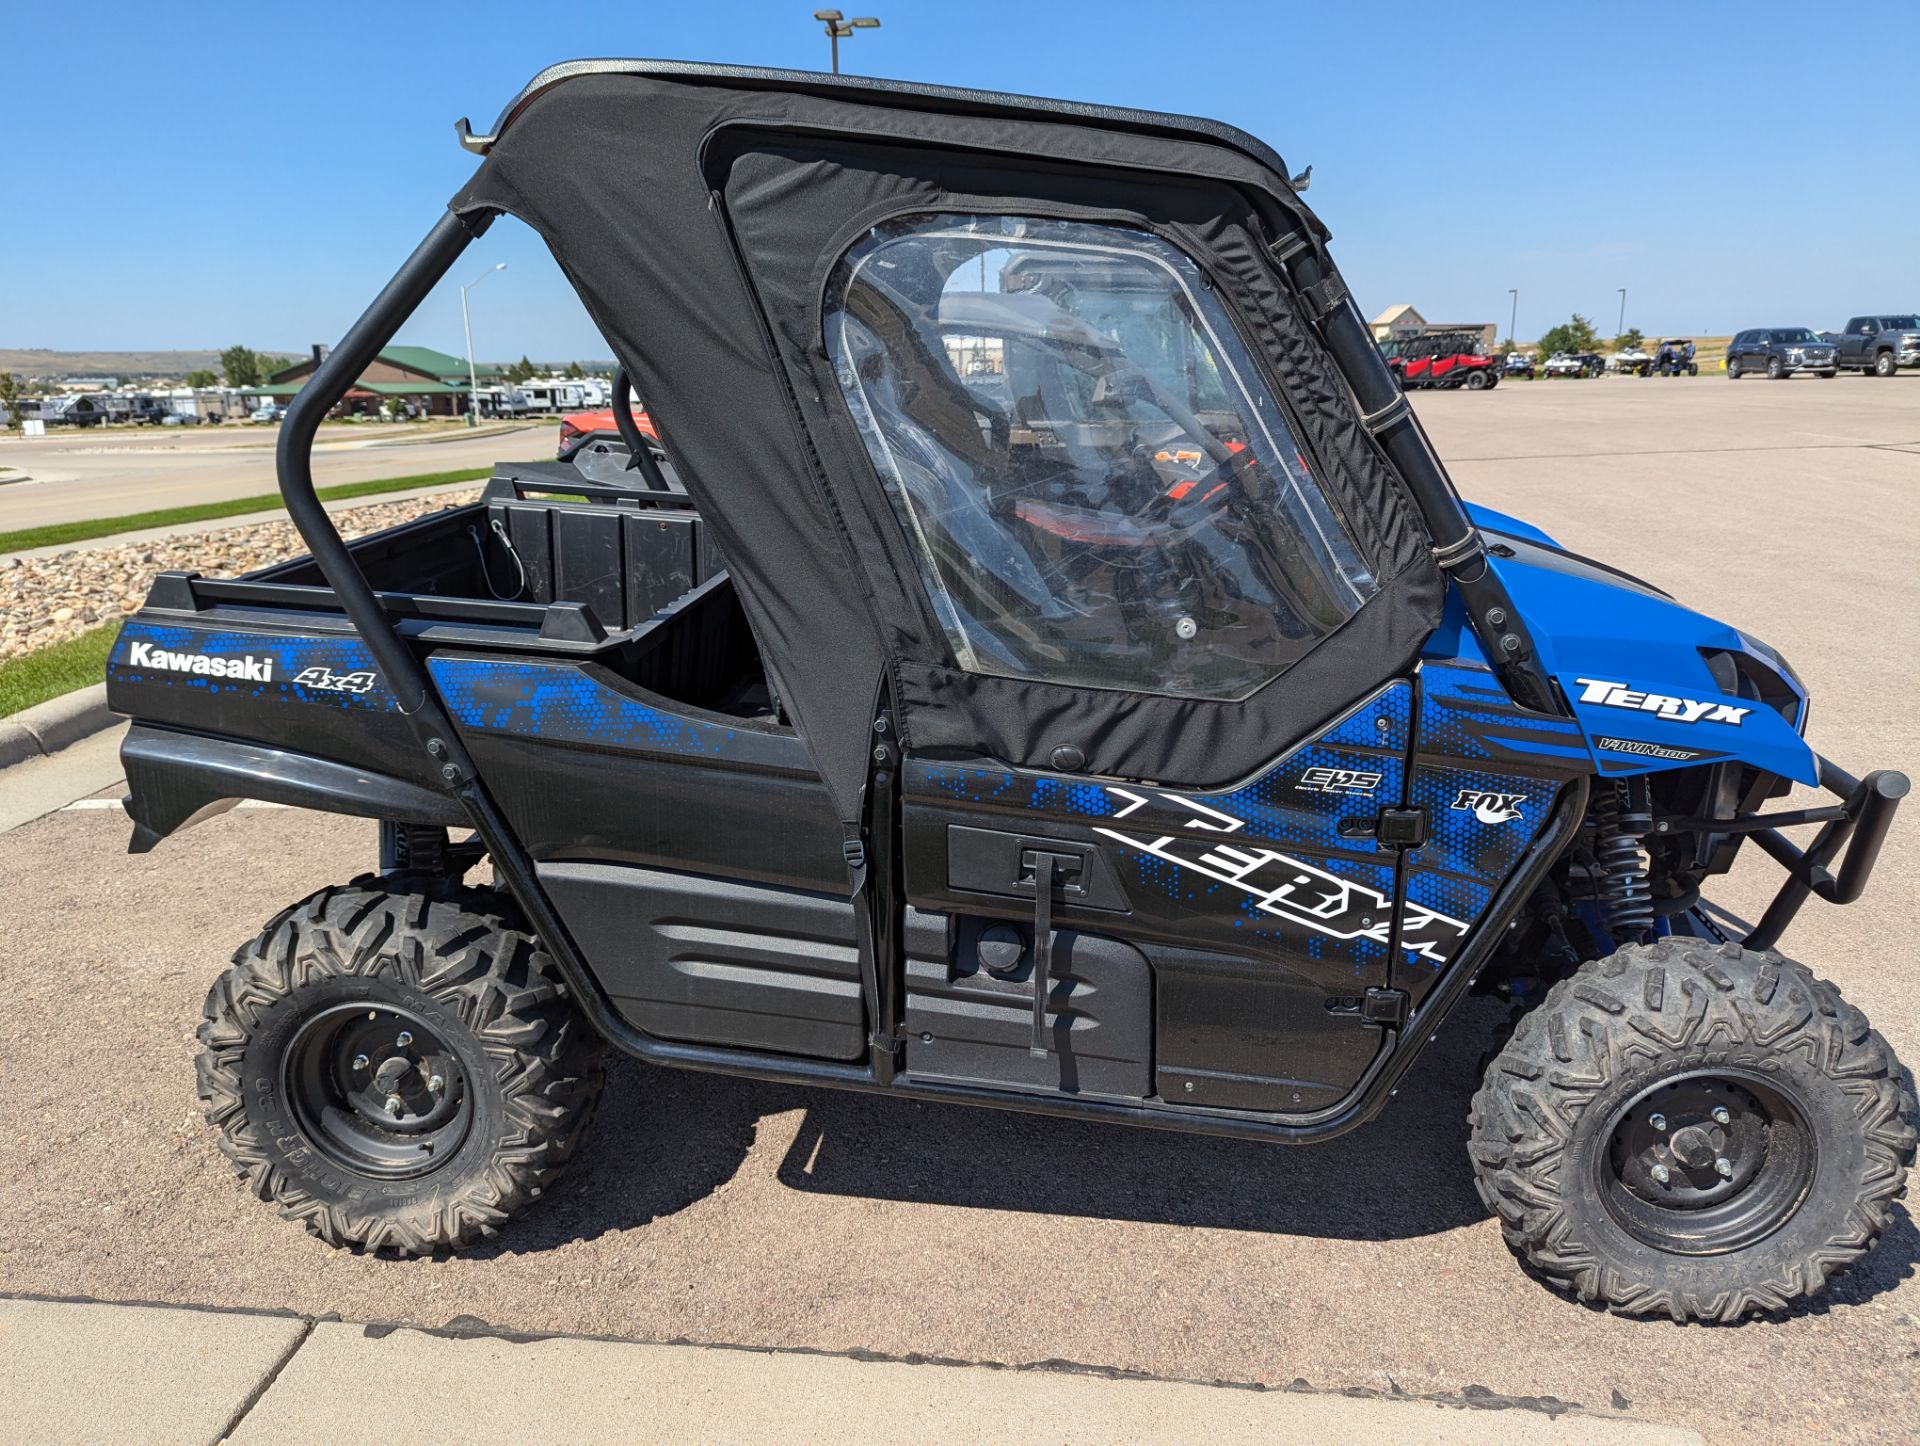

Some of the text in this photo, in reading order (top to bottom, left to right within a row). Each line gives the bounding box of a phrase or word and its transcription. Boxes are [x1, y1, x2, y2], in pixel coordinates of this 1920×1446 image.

[129, 641, 273, 682] Kawasaki
[293, 666, 376, 693] 4x4
[1576, 678, 1752, 724] TERYX
[1301, 767, 1382, 789] EPS
[1450, 790, 1528, 822] FOX
